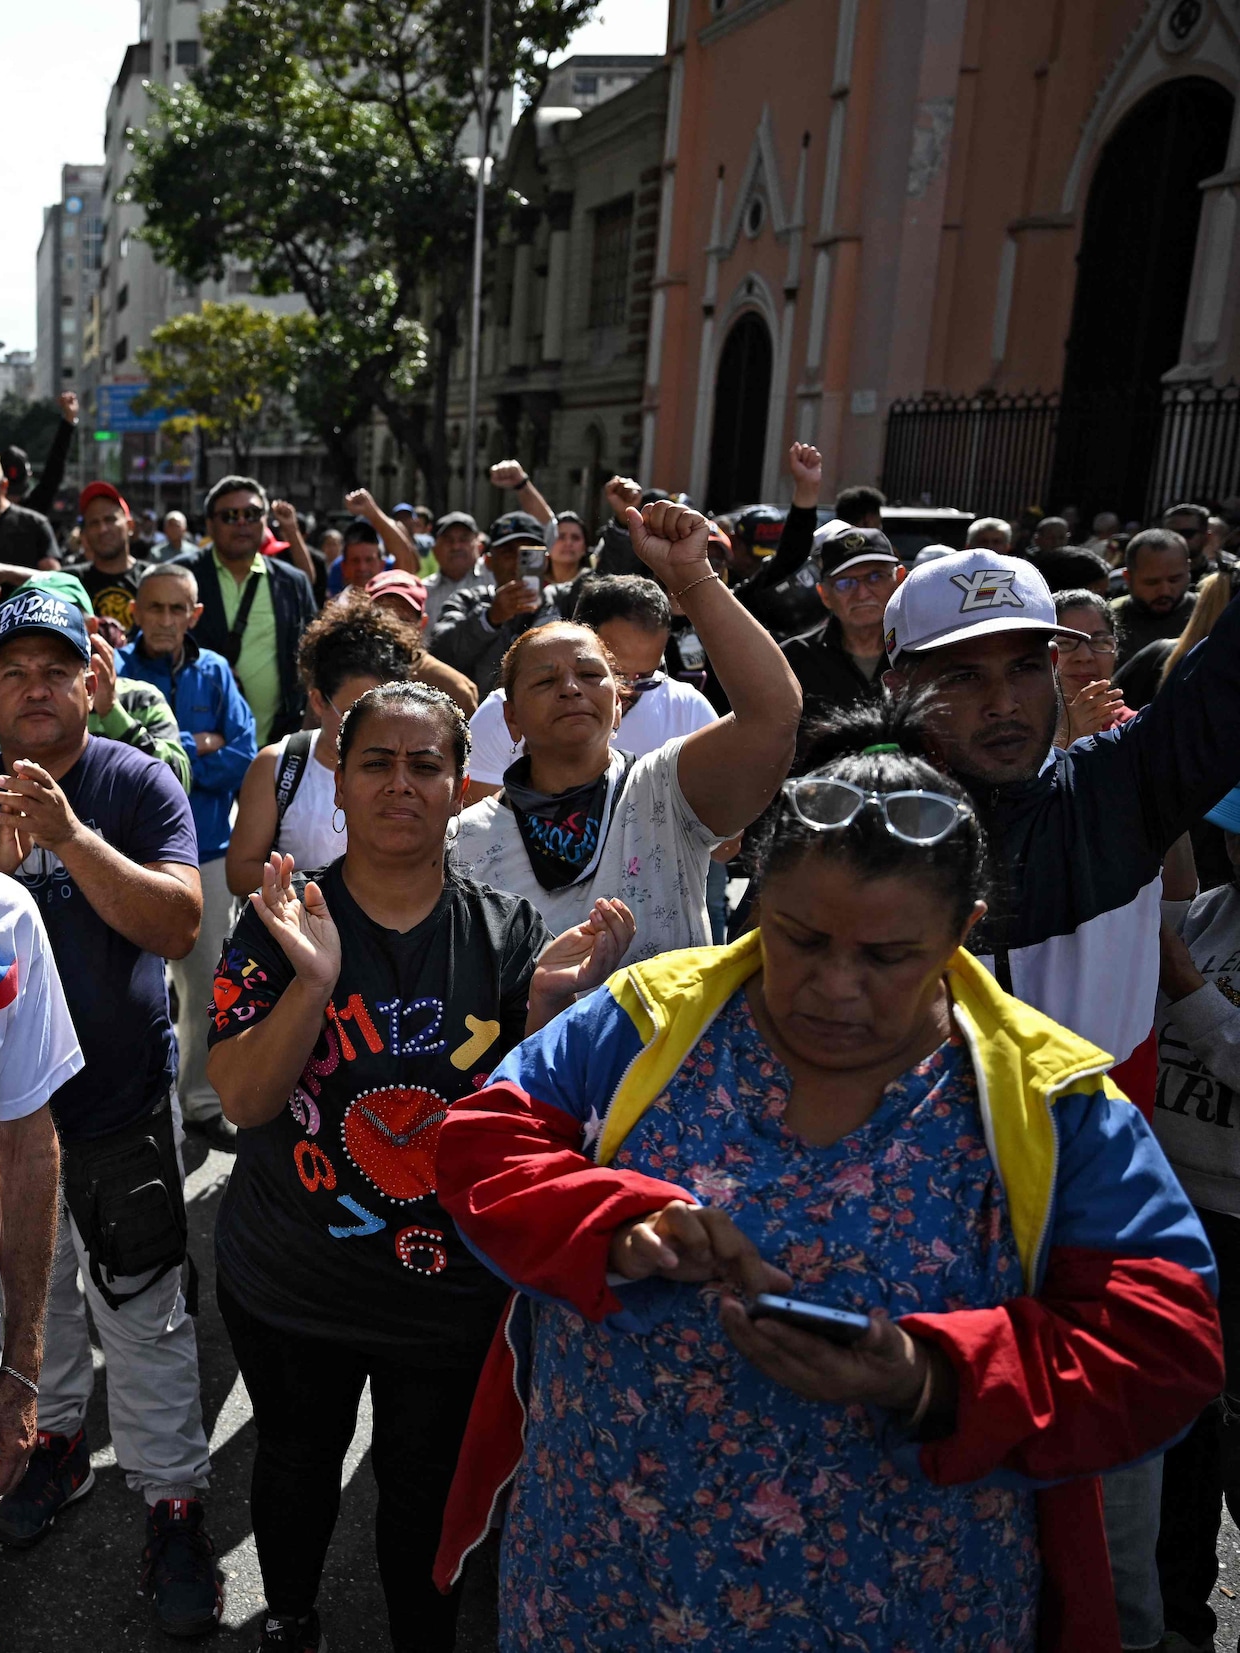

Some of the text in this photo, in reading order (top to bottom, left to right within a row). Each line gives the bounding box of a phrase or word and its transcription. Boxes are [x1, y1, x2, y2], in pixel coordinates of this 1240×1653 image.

[0, 595, 69, 623] DUDAR
[0, 620, 11, 634] ES
[375, 997, 448, 1057] 12
[449, 1013, 501, 1072] 1
[293, 1140, 337, 1193] 8
[328, 1194, 388, 1239] 7
[394, 1226, 448, 1276] 6
